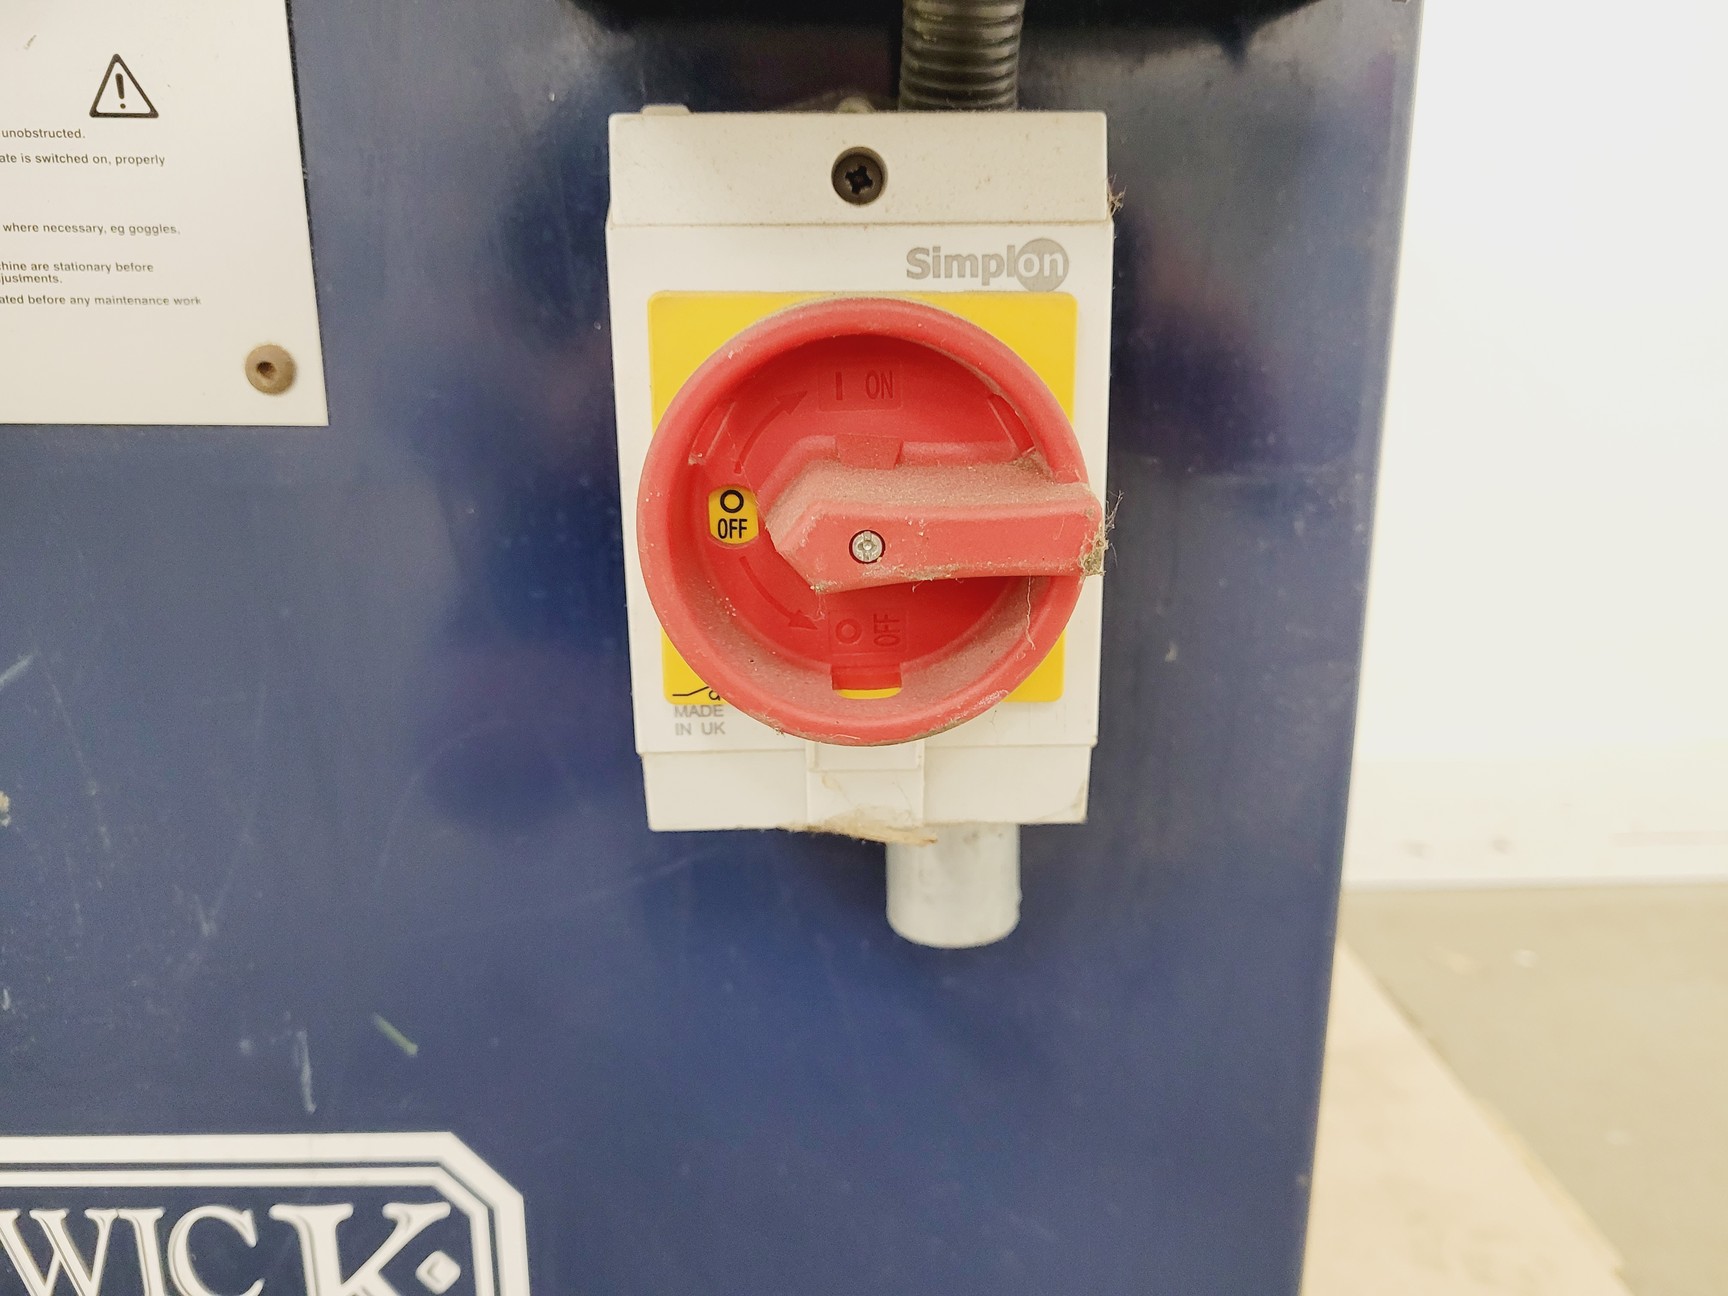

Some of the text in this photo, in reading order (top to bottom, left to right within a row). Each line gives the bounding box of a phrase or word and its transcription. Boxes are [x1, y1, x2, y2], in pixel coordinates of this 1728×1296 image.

[1, 128, 86, 139] unobstructed.
[20, 153, 32, 163] is
[35, 153, 89, 164] switched
[92, 155, 112, 166] on,
[115, 154, 166, 167] properly
[2, 222, 39, 233] where
[42, 224, 107, 236] necessary,
[110, 225, 125, 236] eg
[0, 261, 154, 274] hine are stationary before
[906, 243, 1065, 286] Simplon
[0, 273, 63, 285] justments.
[27, 294, 66, 305] before
[70, 297, 91, 308] any
[94, 296, 170, 306] maintenance
[173, 297, 202, 306] work
[865, 369, 894, 400] ON
[717, 518, 748, 539] OFF
[873, 612, 901, 648] OFF
[673, 704, 725, 718] MADE
[675, 721, 726, 736] IN UK
